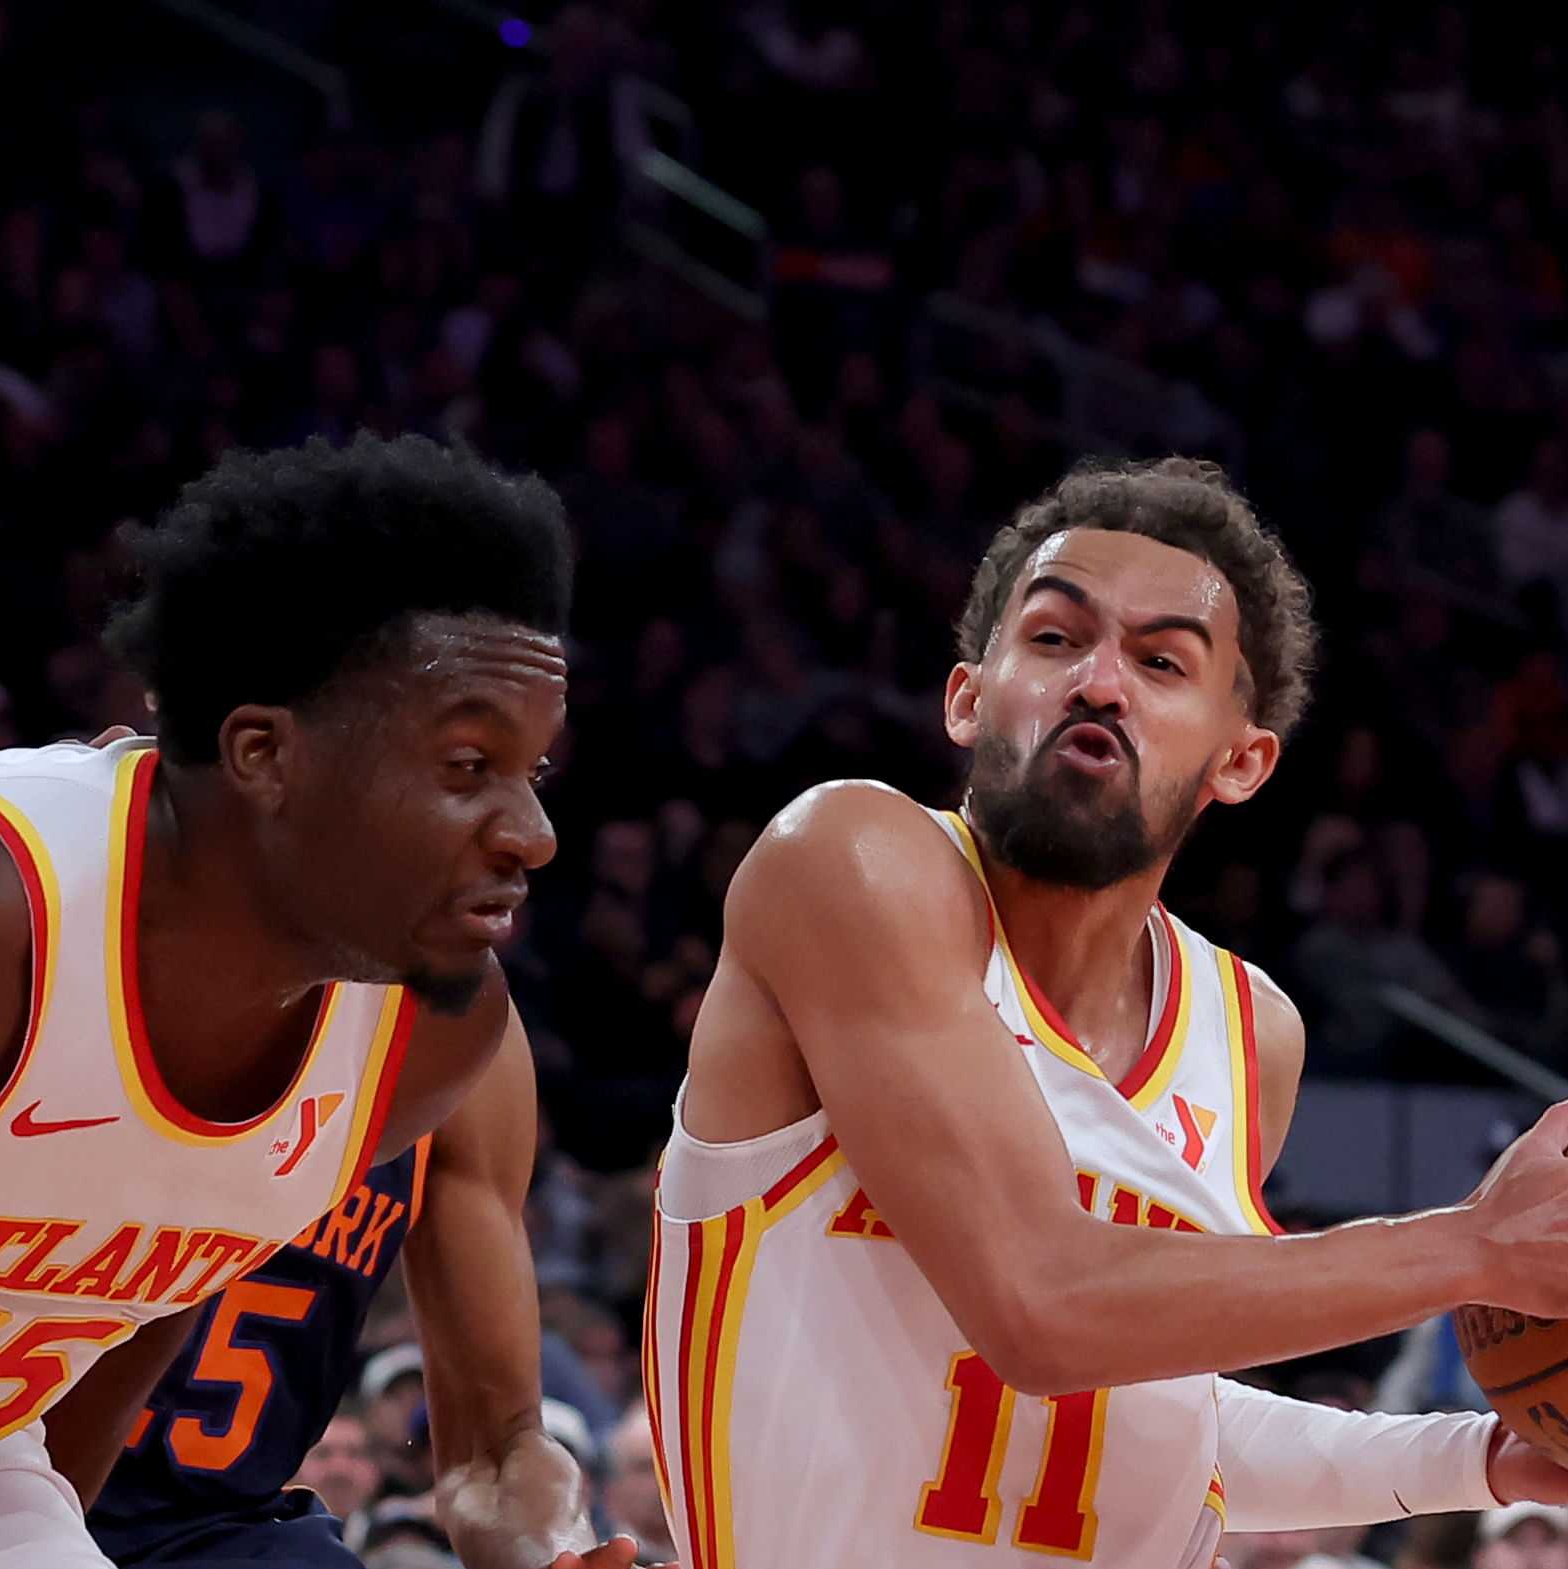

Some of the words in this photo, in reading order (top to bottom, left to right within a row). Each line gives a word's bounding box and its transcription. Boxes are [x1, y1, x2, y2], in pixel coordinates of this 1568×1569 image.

[1154, 1121, 1176, 1146] the
[289, 1184, 406, 1277] RK
[124, 1279, 318, 1472] 5
[912, 1348, 1111, 1562] 11
